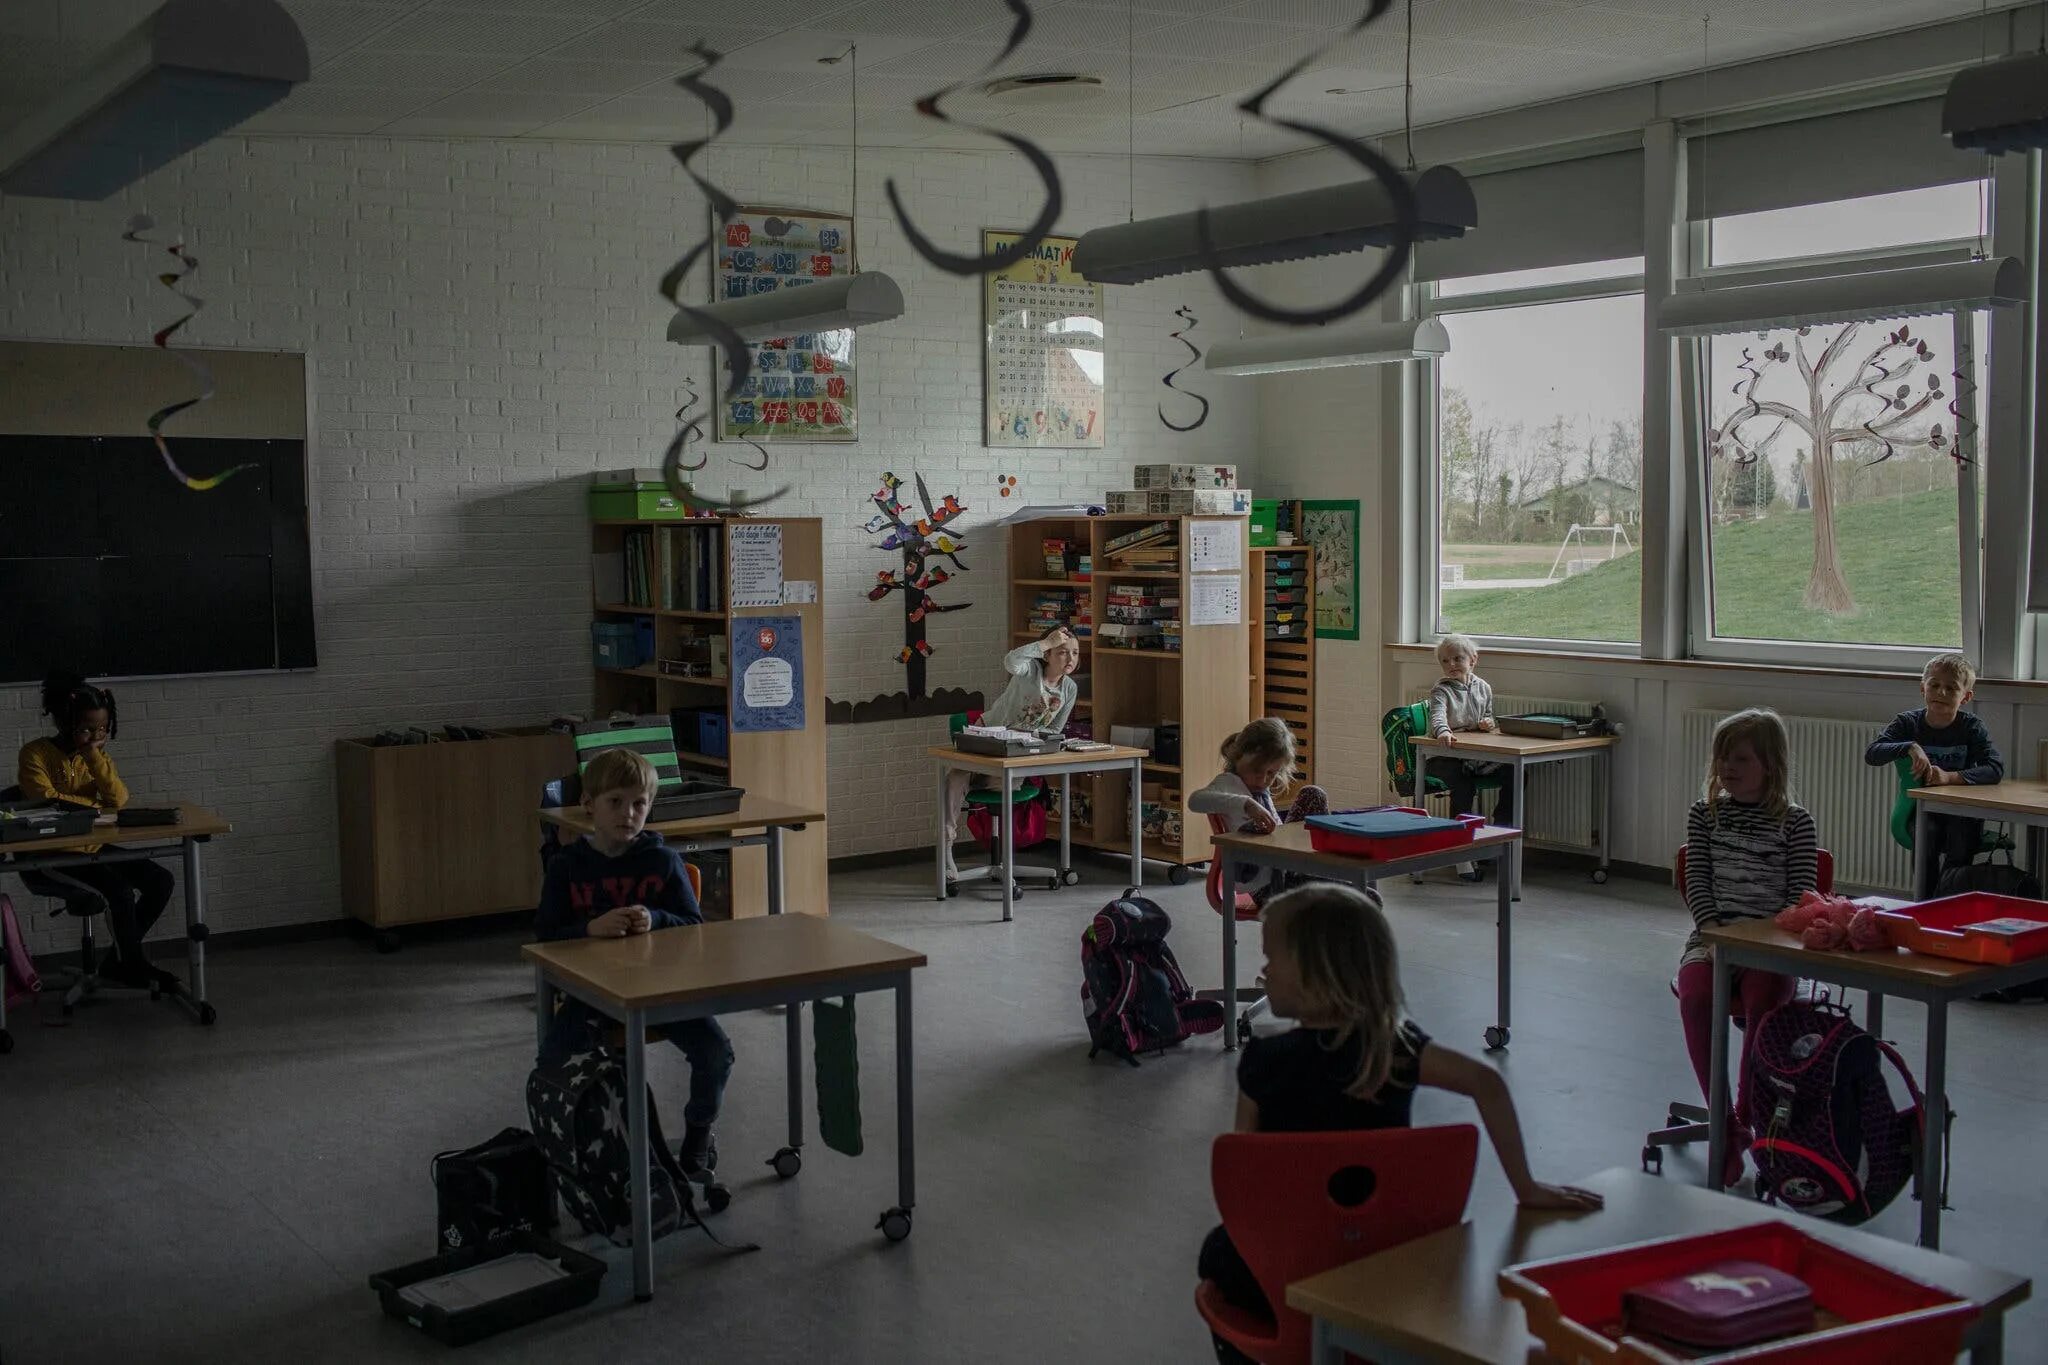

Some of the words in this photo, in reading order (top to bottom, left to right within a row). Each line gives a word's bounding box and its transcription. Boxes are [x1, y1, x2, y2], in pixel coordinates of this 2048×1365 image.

[729, 226, 748, 241] Aa
[822, 230, 838, 246] Bb
[736, 251, 753, 268] Cc
[776, 253, 794, 269] Dd
[814, 256, 829, 271] Ee
[729, 277, 745, 293] Ff
[760, 352, 775, 368] Ss
[796, 377, 813, 393] Xx
[830, 377, 843, 396] Yy
[735, 404, 752, 418] Zz
